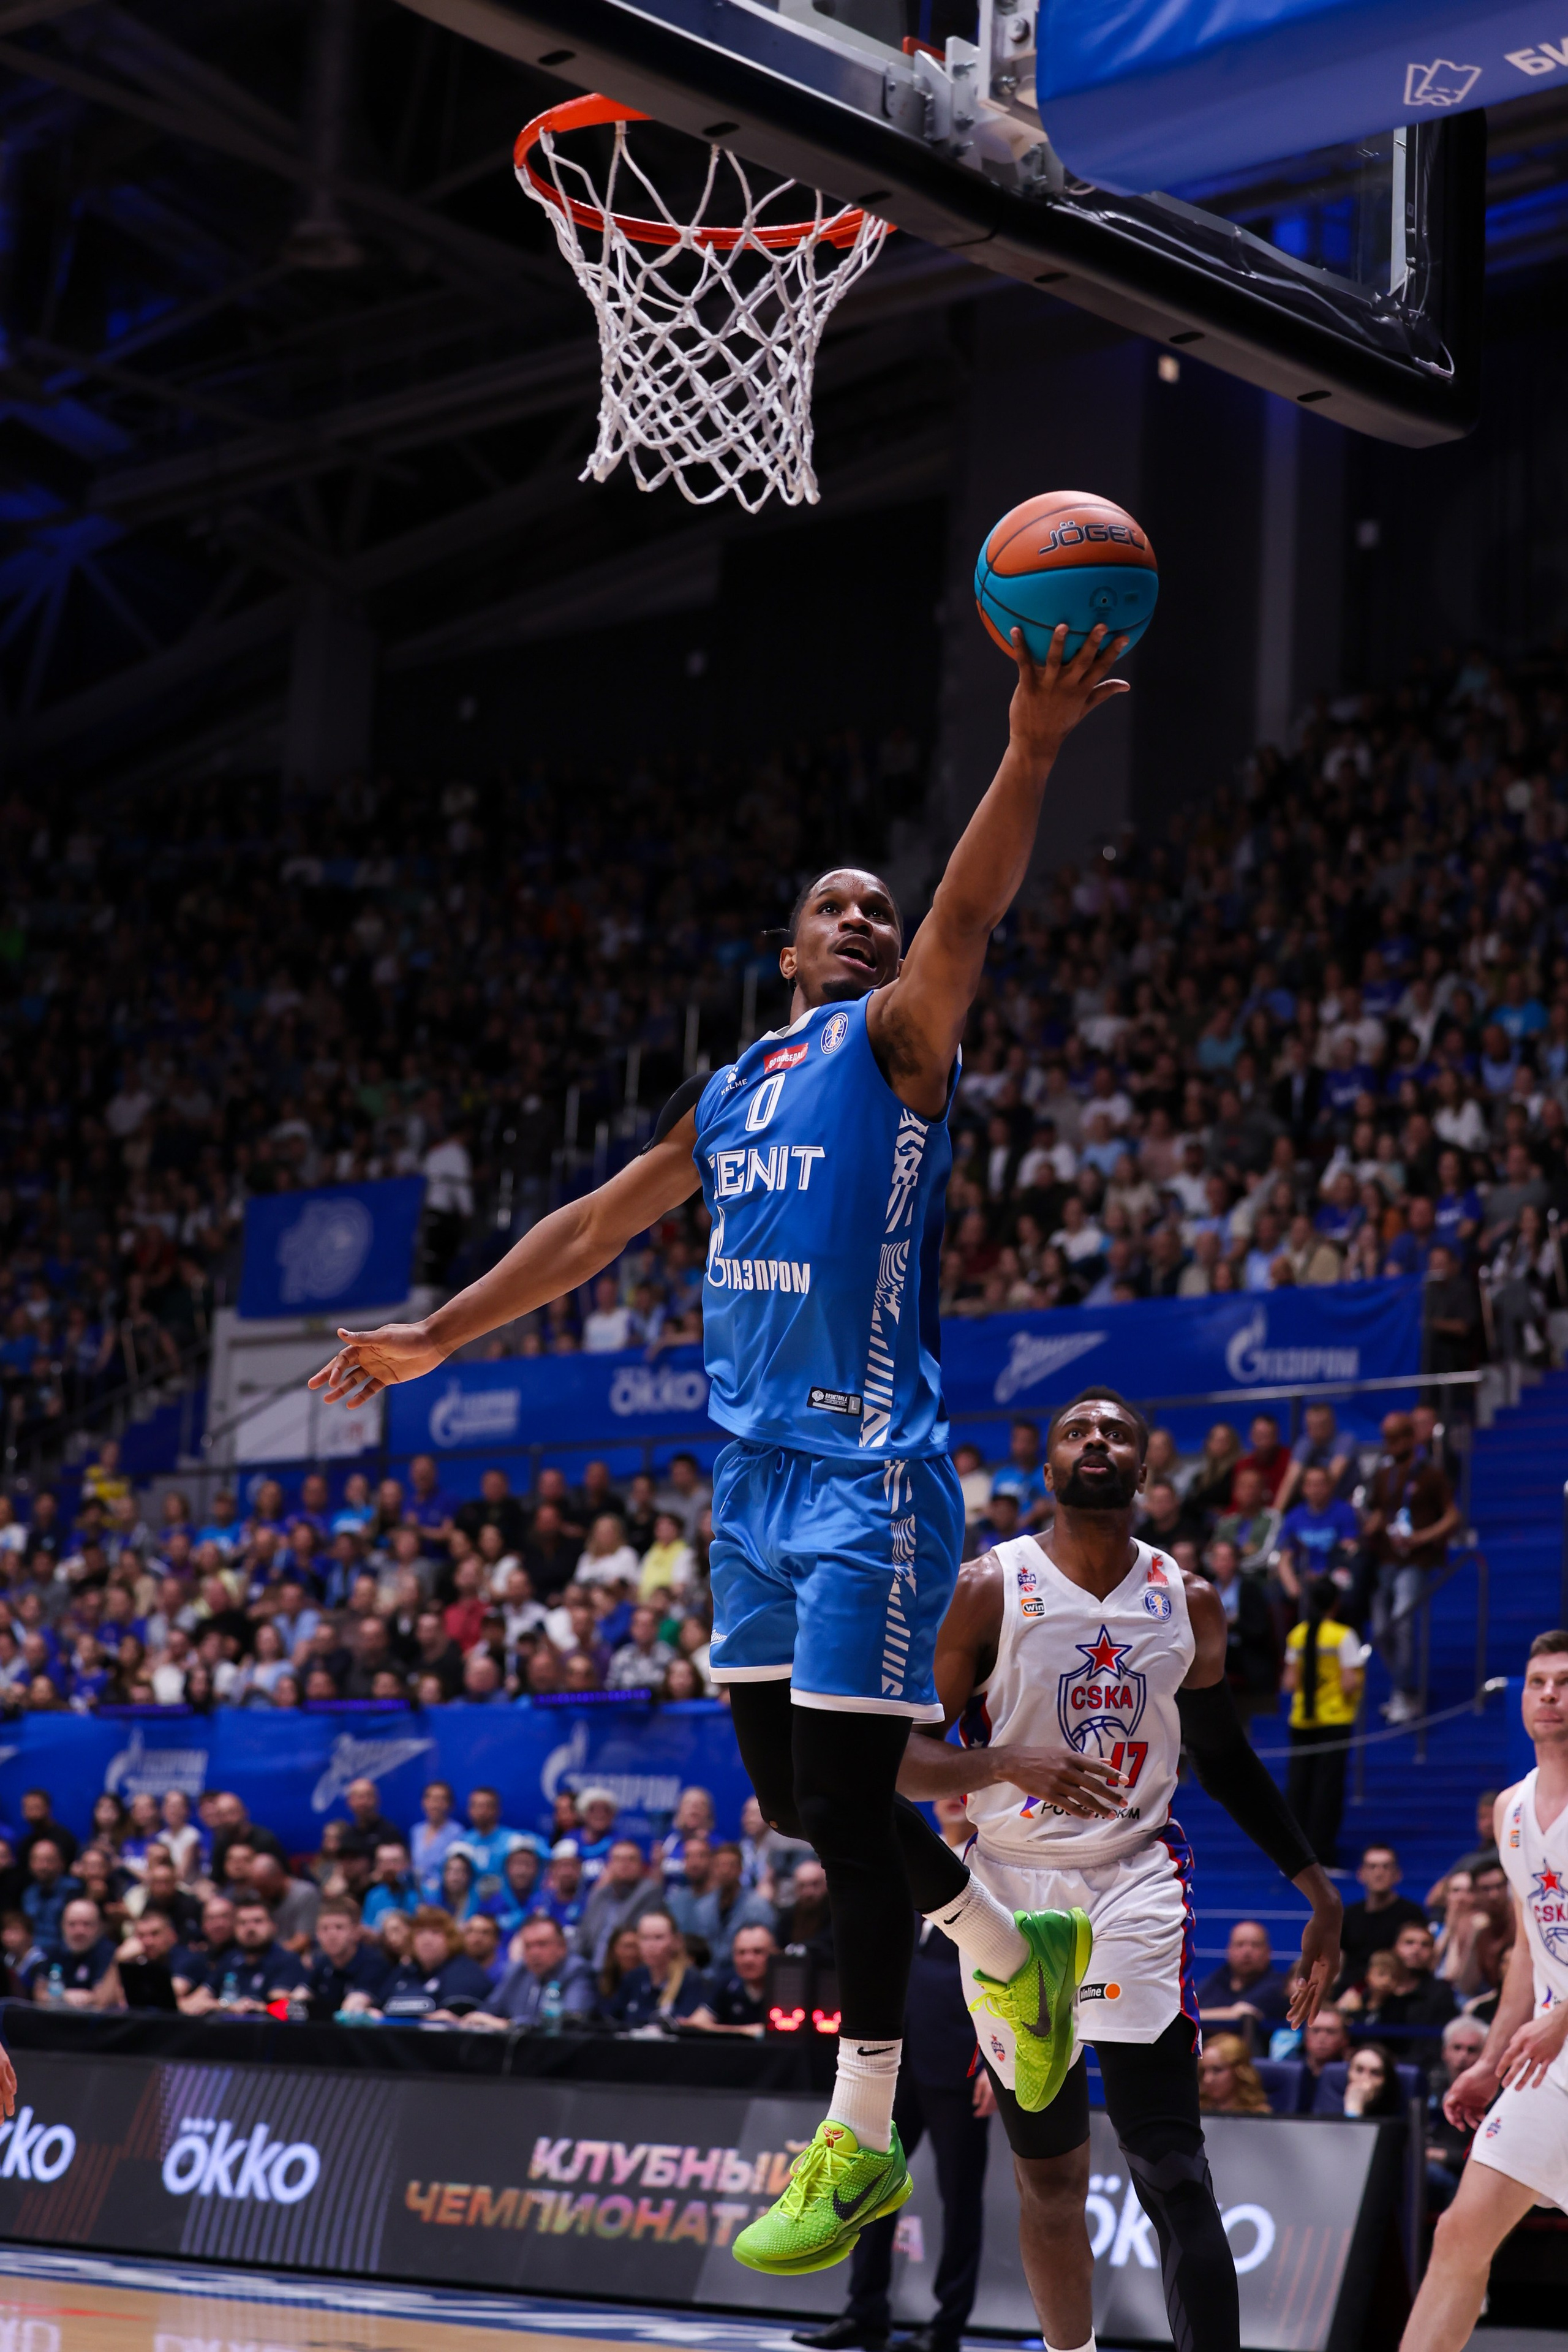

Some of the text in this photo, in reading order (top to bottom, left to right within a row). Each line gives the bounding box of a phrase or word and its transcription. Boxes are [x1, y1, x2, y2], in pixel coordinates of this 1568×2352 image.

[1038, 521, 1145, 555] JÖGEL
[721, 1078, 748, 1096] KELME
[745, 1072, 786, 1132] 0
[851, 1400, 857, 1411] L
[1018, 1575, 1036, 1583] CSKA
[1071, 1685, 1133, 1709] CSKA
[1534, 1902, 1568, 1924] CSK
[404, 2179, 750, 2247] ЧЕМПИОНАТ
